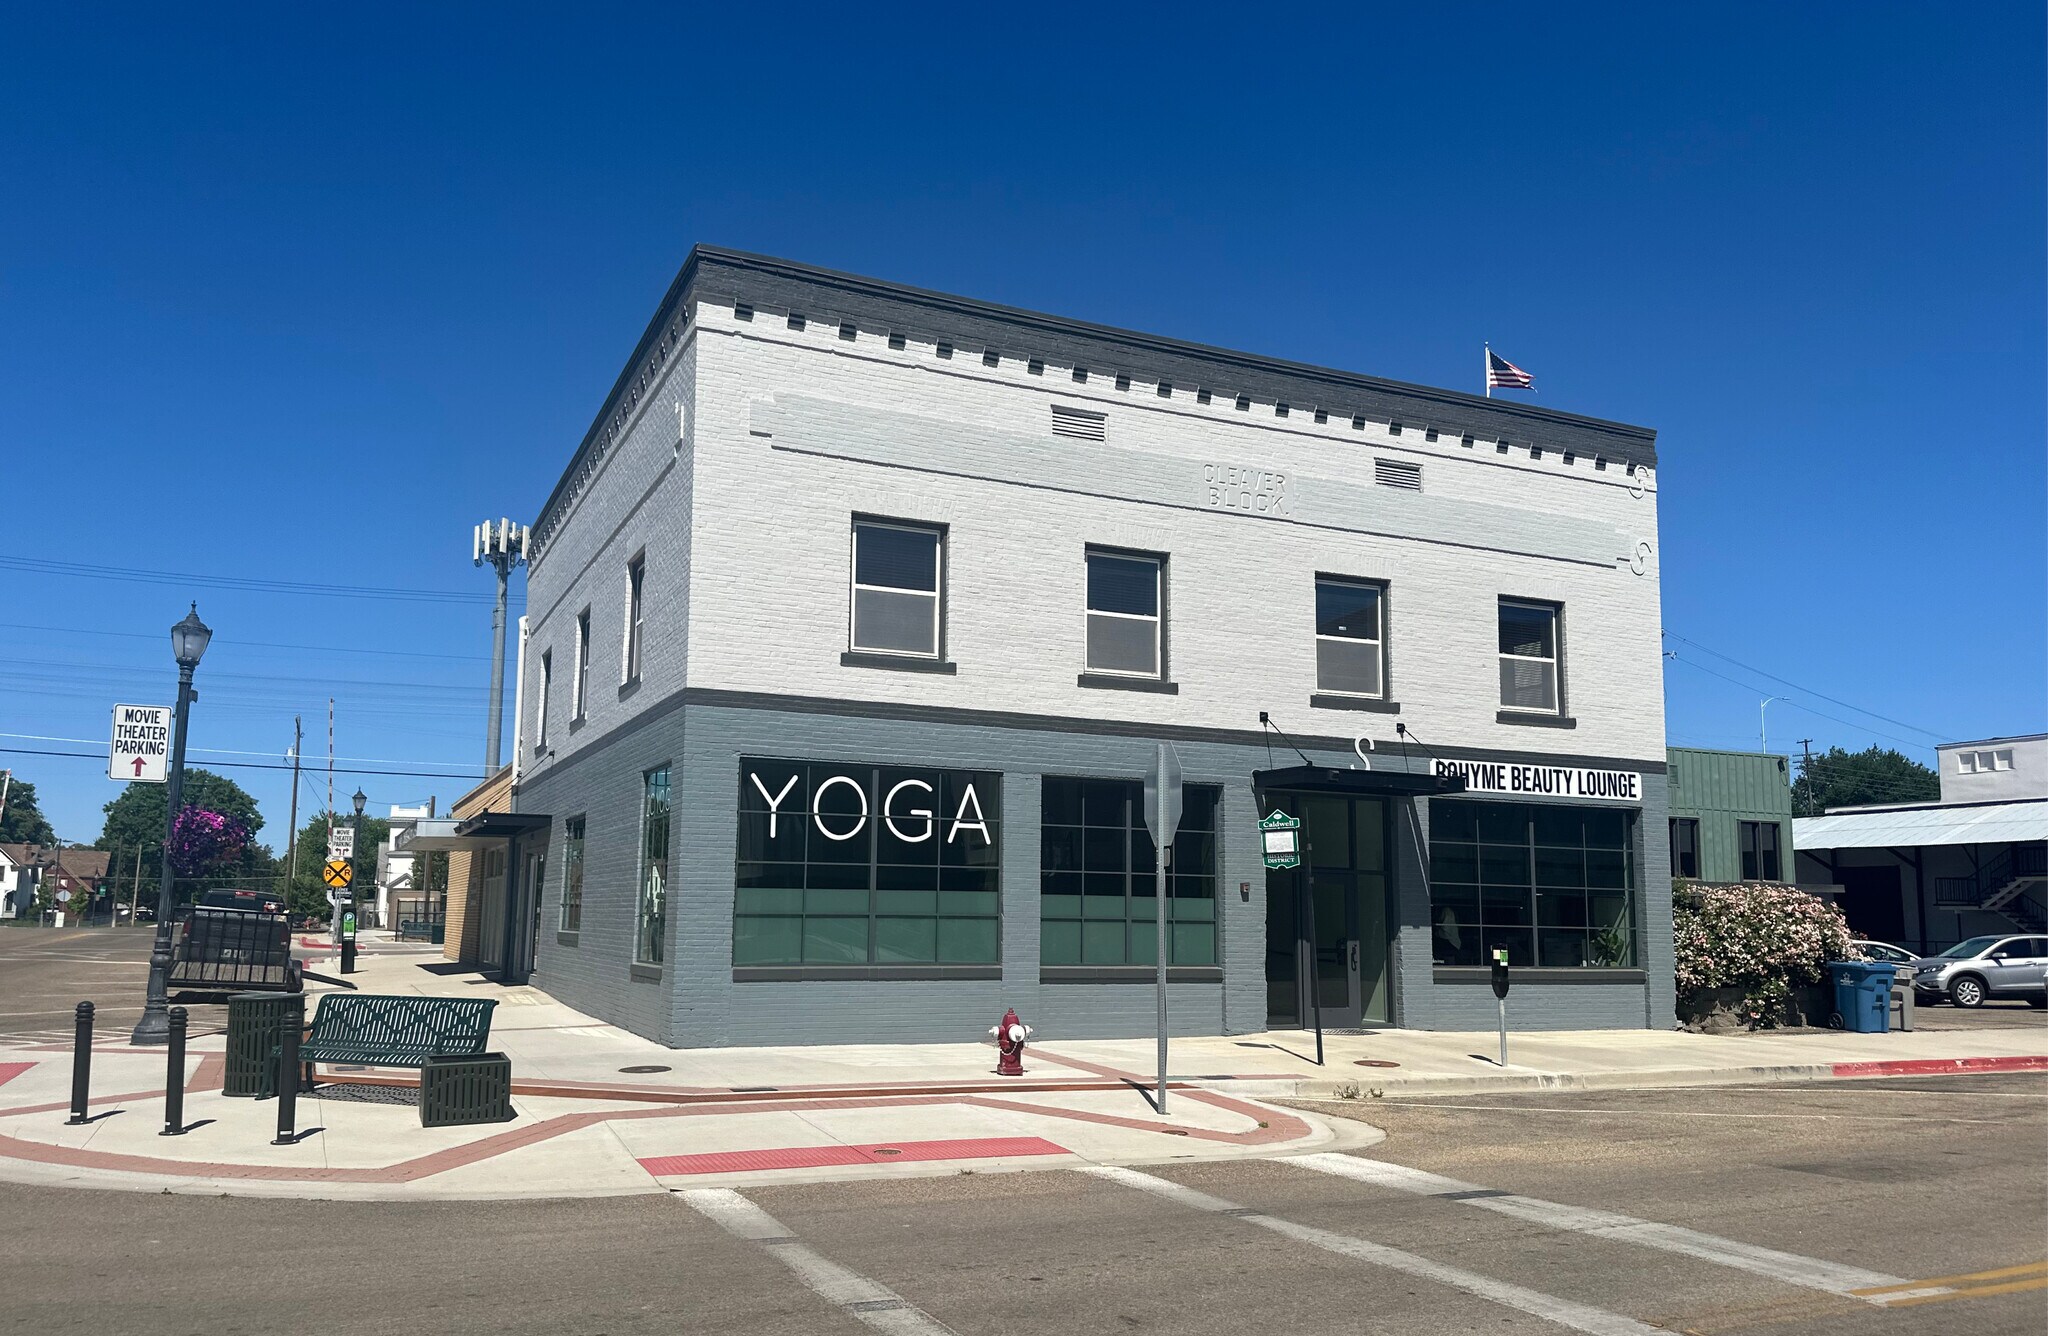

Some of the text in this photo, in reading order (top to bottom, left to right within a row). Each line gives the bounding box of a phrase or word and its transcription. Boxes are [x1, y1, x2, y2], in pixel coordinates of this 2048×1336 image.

[1204, 464, 1286, 494] CLEAVER
[125, 709, 161, 724] MOVIE
[117, 725, 167, 740] THEATER
[115, 740, 165, 755] PARKING
[1511, 766, 1573, 795] BEAUTY
[1578, 770, 1637, 798] LOUNGE
[750, 772, 992, 846] YOGA
[1263, 820, 1294, 828] Caldwell
